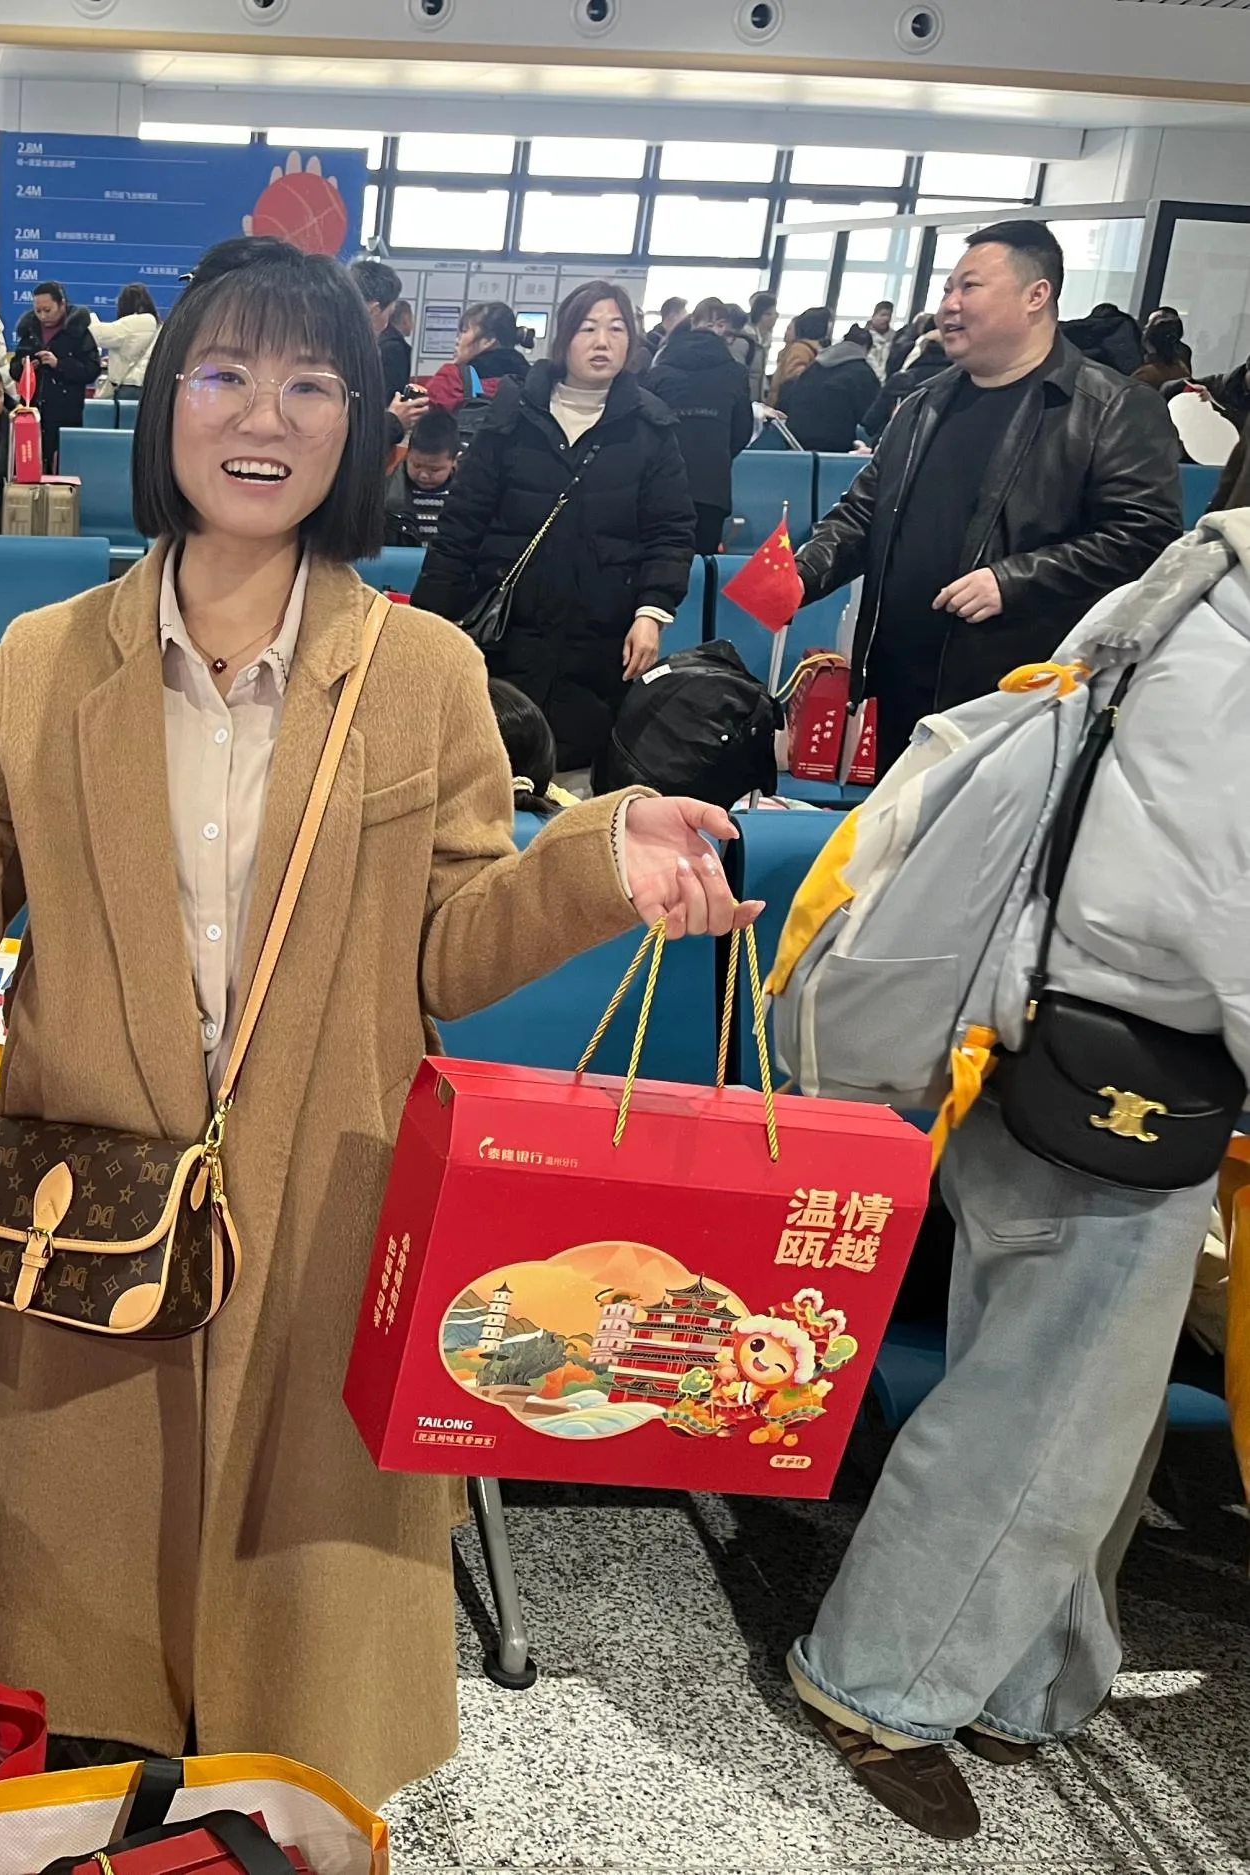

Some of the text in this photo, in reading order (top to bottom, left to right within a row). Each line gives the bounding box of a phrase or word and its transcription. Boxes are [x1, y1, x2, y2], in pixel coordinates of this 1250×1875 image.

[17, 142, 43, 154] 2.8M
[16, 184, 42, 197] 2.4M
[14, 228, 40, 240] 2.0M
[14, 248, 39, 260] 1.8M
[14, 269, 38, 281] 1.6M
[487, 1147, 579, 1169] 泰隆银行 温州分行
[785, 1187, 894, 1234] 温情
[773, 1228, 881, 1273] 瓯越
[417, 1416, 474, 1431] TAILONG
